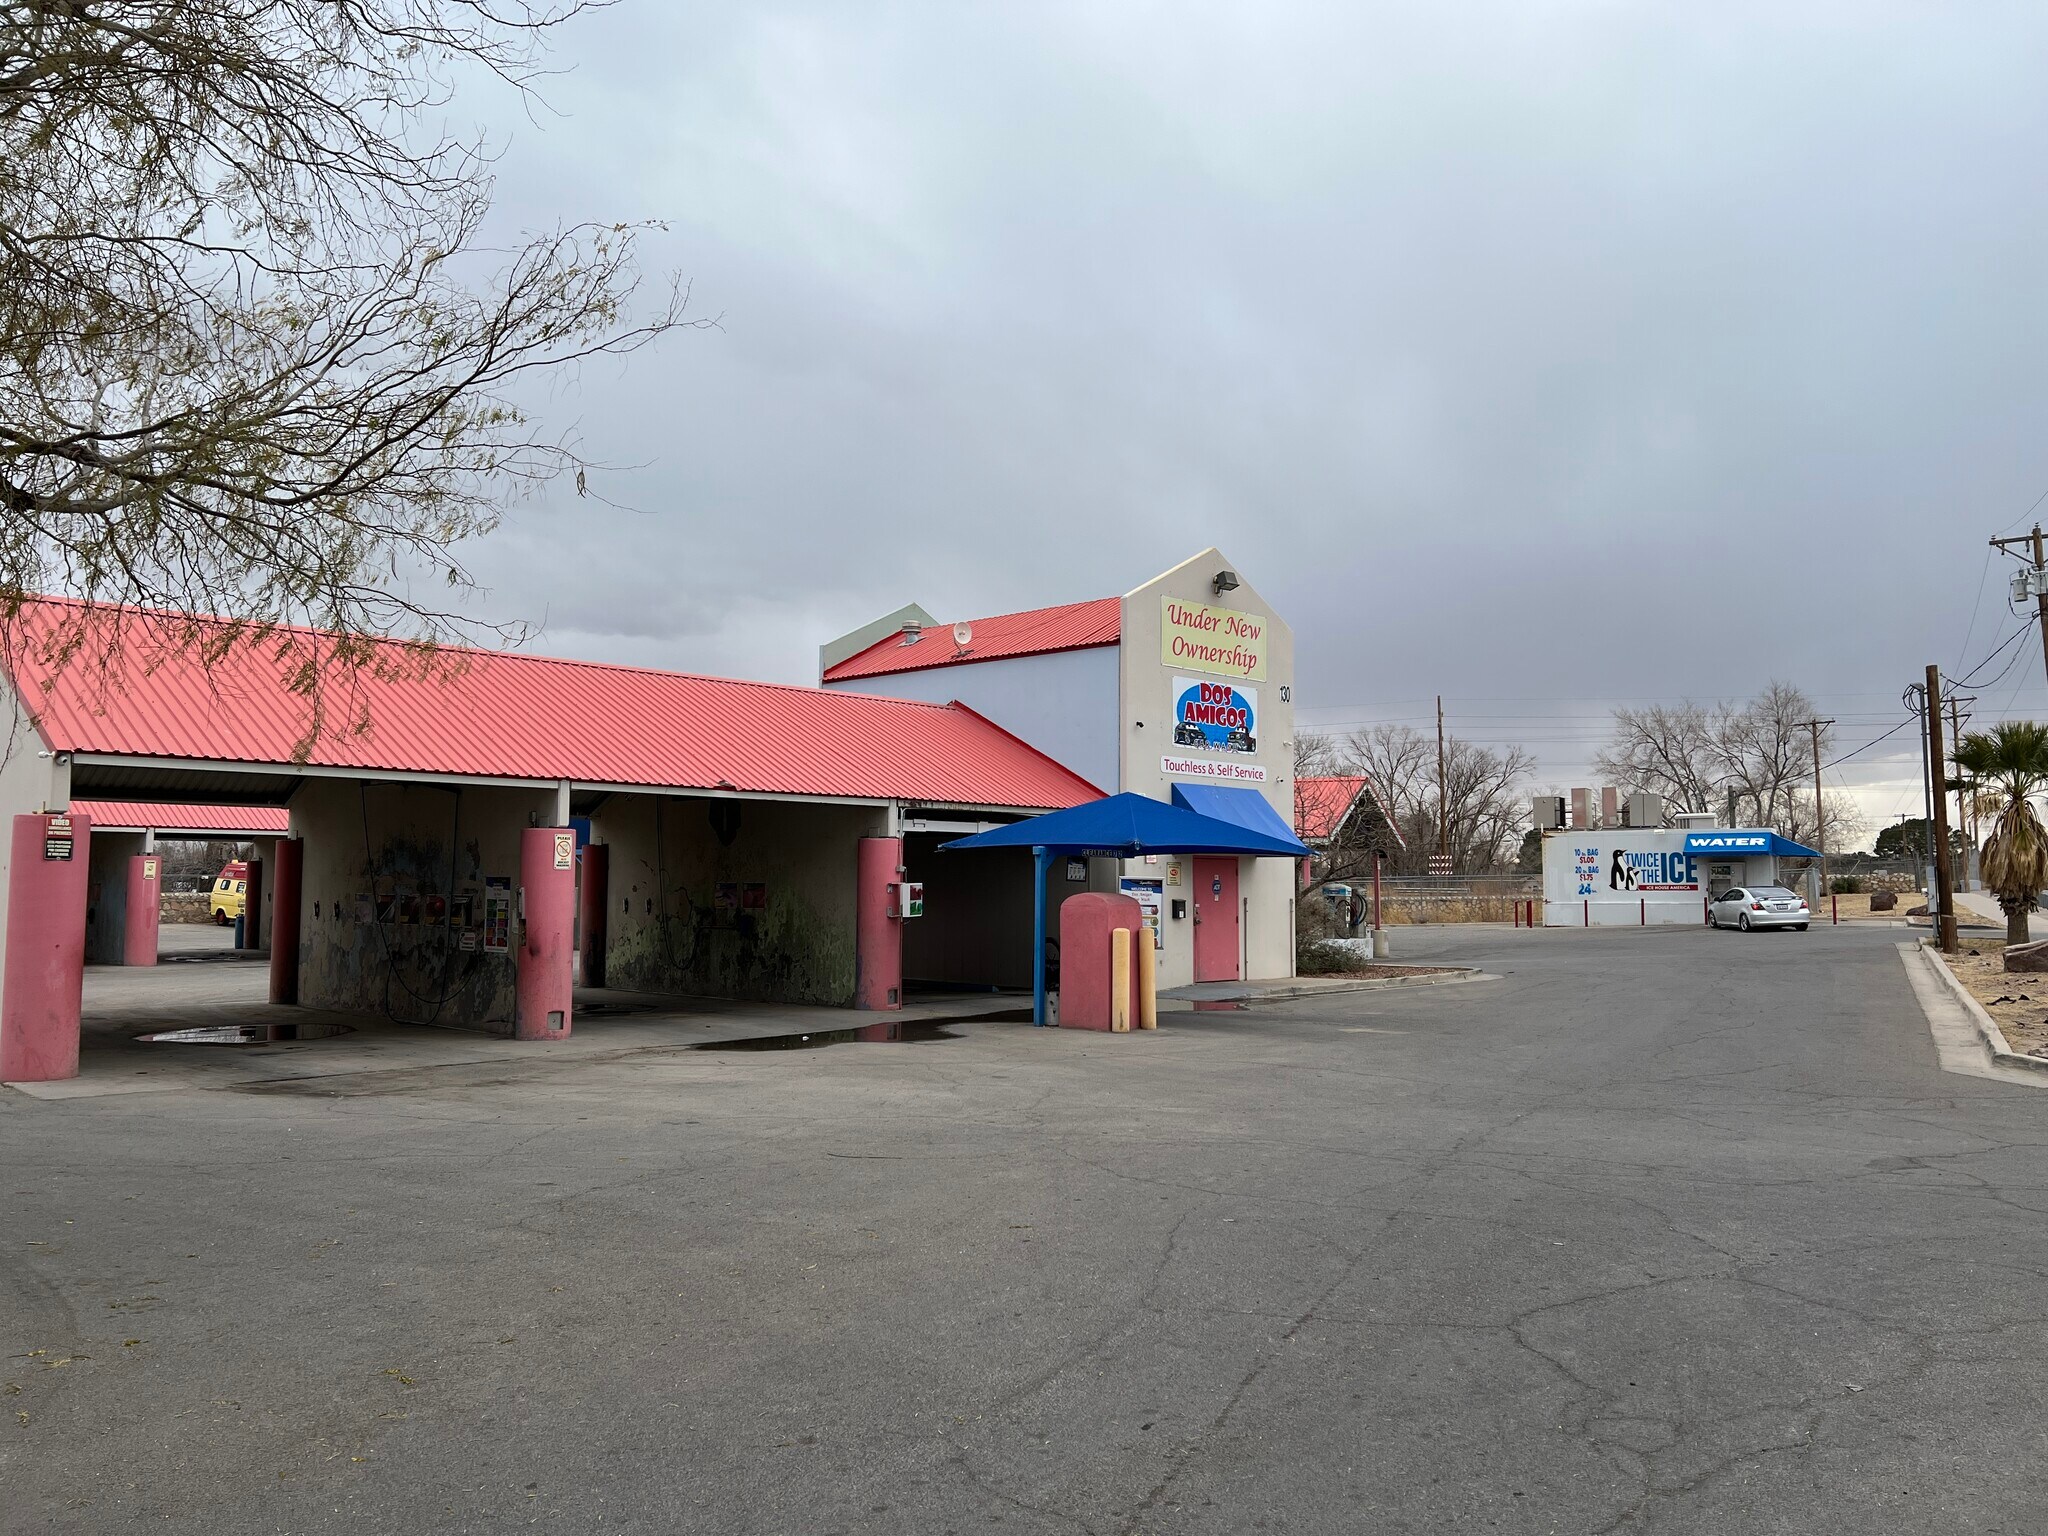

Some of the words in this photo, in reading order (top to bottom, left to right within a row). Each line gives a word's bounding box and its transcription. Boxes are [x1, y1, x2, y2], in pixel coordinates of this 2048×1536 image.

[1167, 604, 1221, 632] Under
[1225, 616, 1261, 640] New
[1172, 636, 1257, 675] Ownership
[1200, 682, 1232, 705] DOS
[1185, 702, 1246, 728] AMIGOS
[1164, 758, 1206, 774] Touchless
[1208, 763, 1215, 775] &
[1217, 764, 1233, 777] Self
[1235, 766, 1264, 780] Service
[1690, 838, 1766, 847] WATER
[1587, 848, 1599, 856] BAG
[1625, 853, 1659, 867] TWICE
[1588, 866, 1599, 874] BAG
[1641, 869, 1660, 883] THE
[1661, 852, 1698, 883] ICE
[1578, 883, 1591, 895] 24
